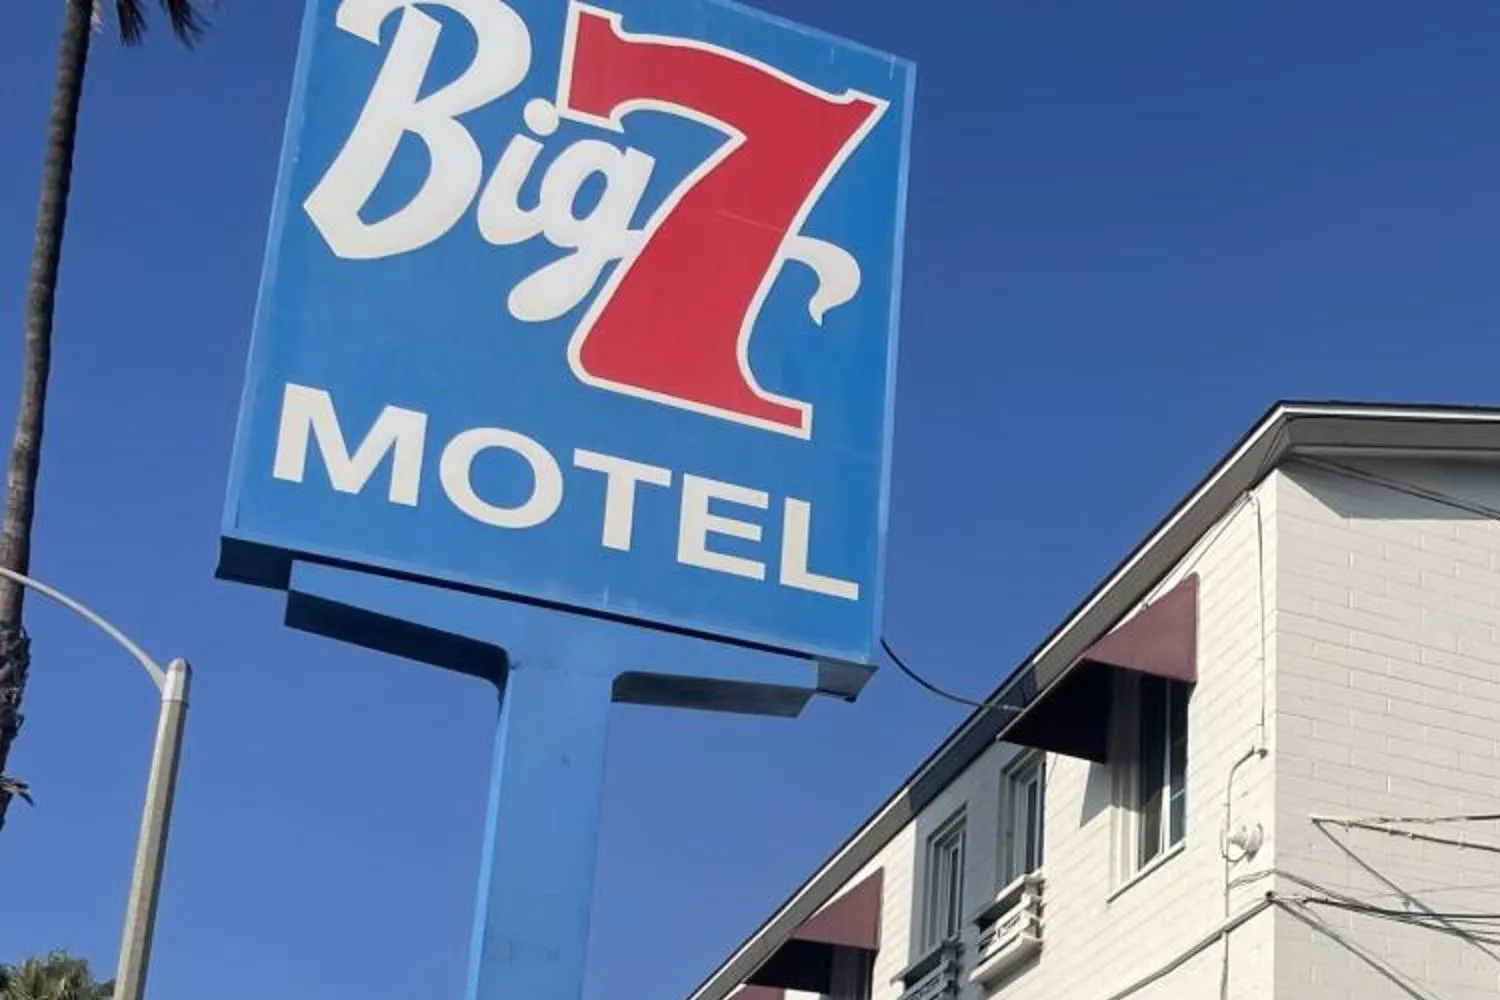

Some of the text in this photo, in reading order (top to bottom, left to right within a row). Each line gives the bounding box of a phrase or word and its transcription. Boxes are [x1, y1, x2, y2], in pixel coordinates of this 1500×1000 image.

[303, 0, 890, 440] Big 7
[272, 383, 860, 602] MOTEL
